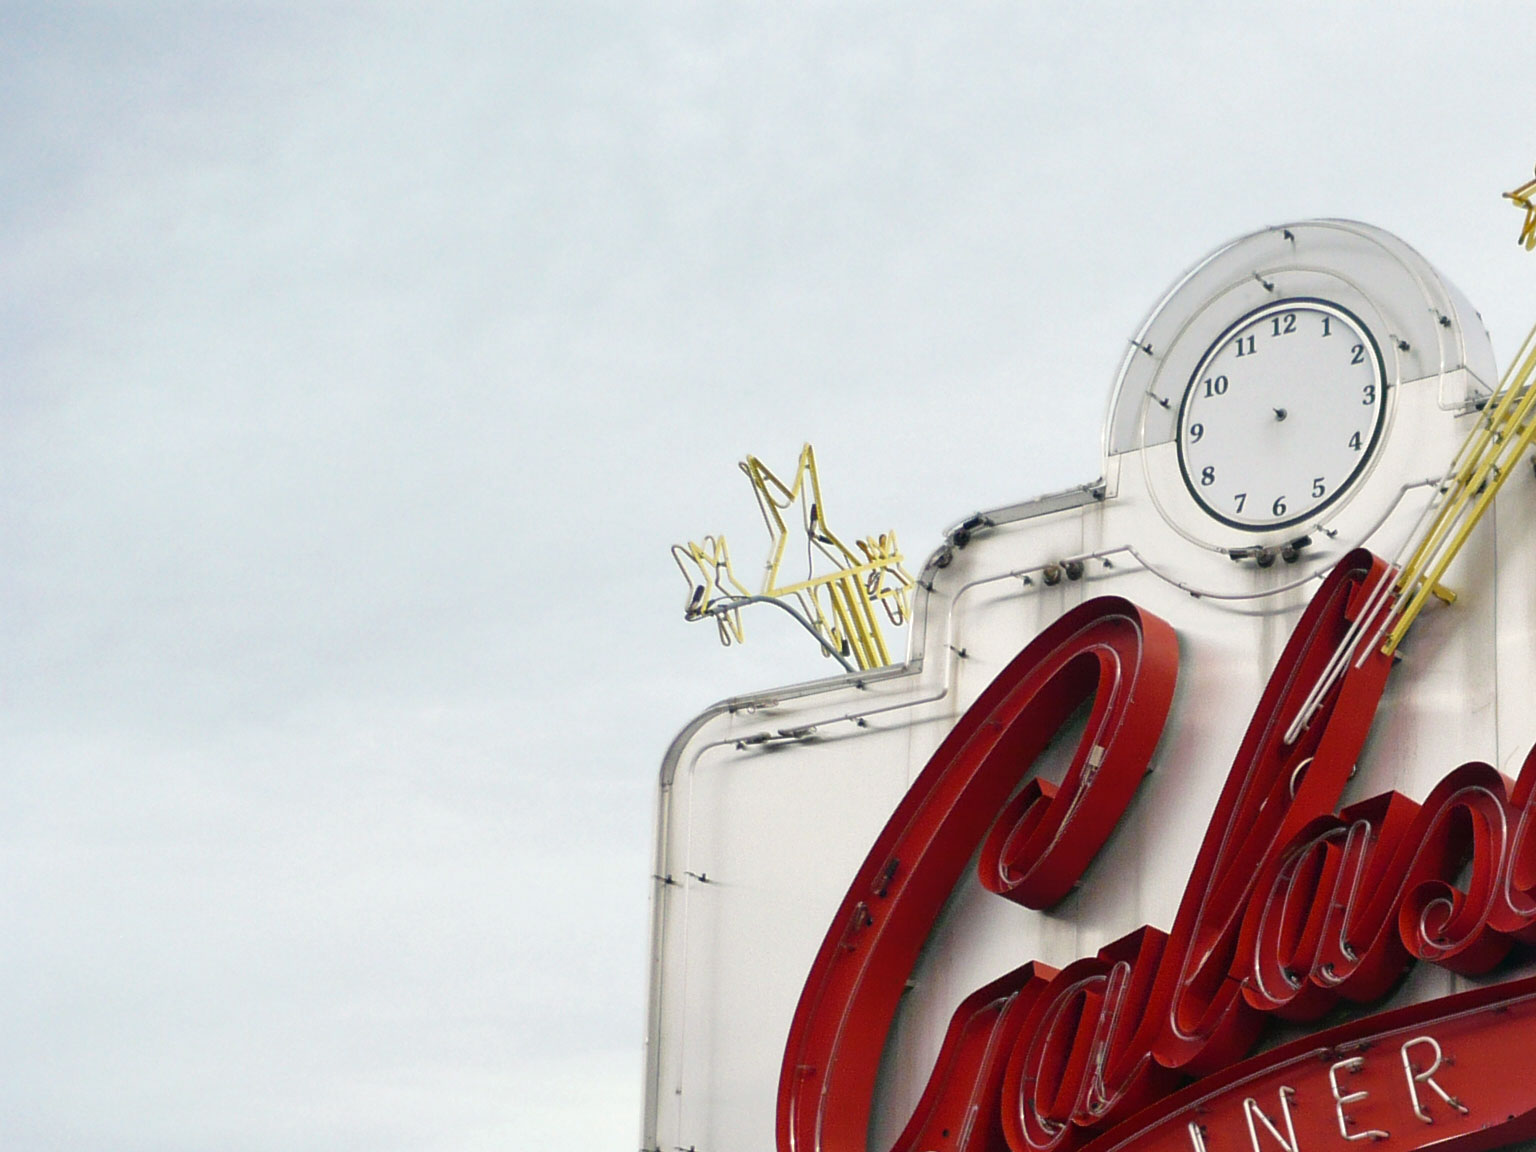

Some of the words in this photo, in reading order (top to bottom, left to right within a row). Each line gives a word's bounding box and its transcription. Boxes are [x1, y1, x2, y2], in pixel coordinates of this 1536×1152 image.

[1271, 313, 1297, 337] 12
[1321, 317, 1332, 337] 1
[1235, 335, 1257, 357] 11
[1350, 344, 1365, 365] 2
[1203, 375, 1228, 398] 10
[1362, 384, 1376, 405] 3
[1190, 423, 1204, 444] 9
[1348, 431, 1363, 451] 4
[1201, 466, 1215, 486] 8
[1312, 477, 1326, 498] 5
[1234, 493, 1247, 513] 7
[1272, 495, 1287, 516] 6
